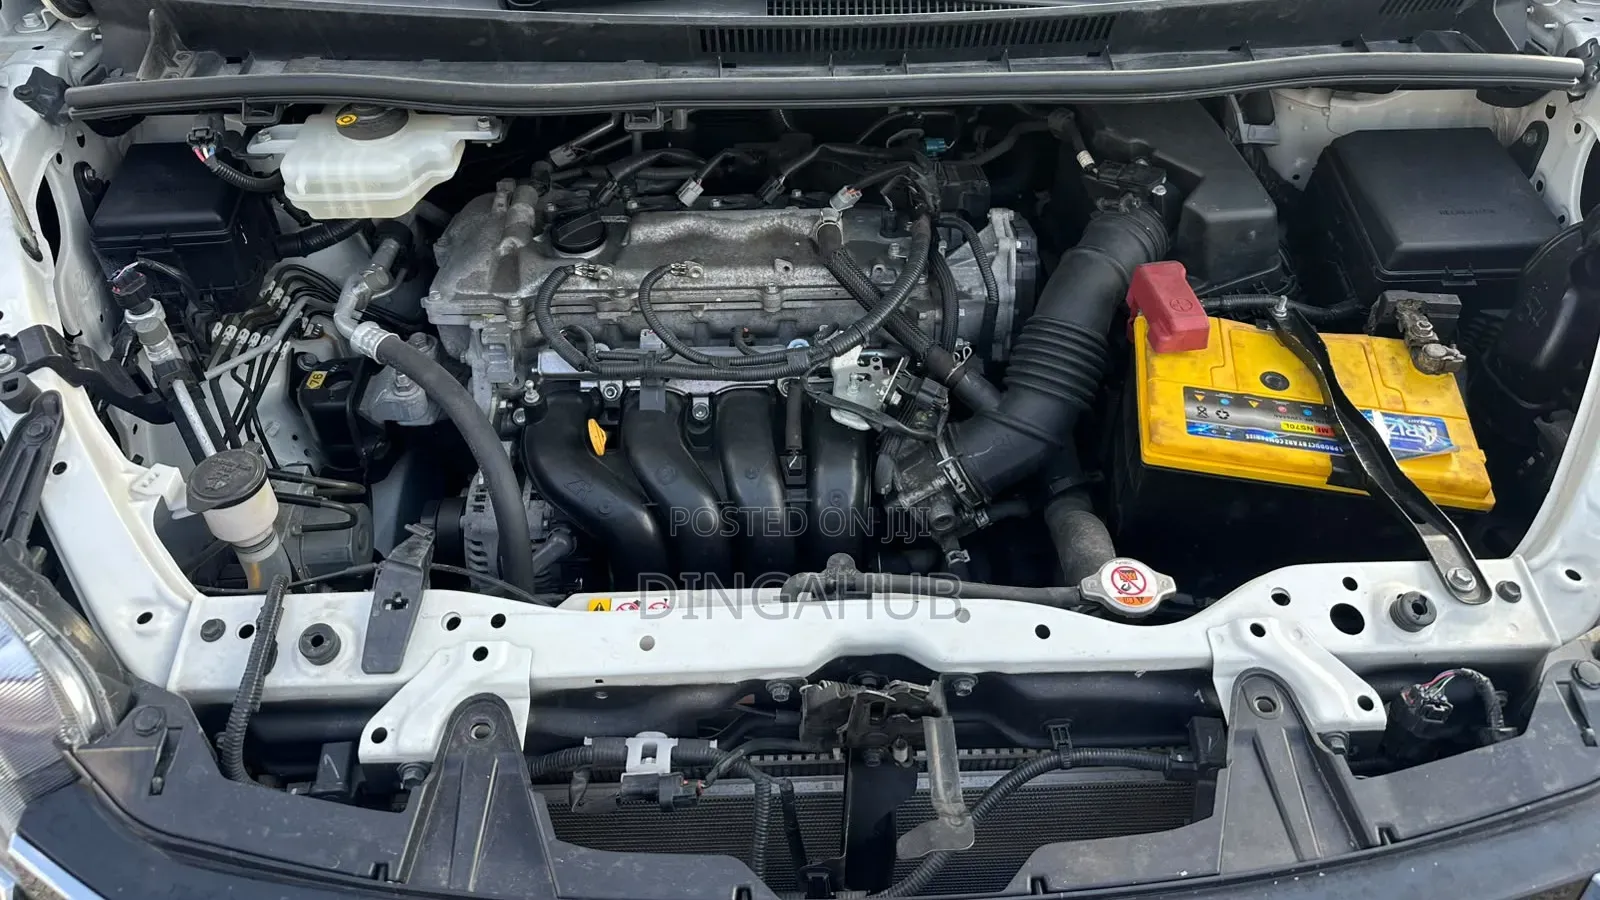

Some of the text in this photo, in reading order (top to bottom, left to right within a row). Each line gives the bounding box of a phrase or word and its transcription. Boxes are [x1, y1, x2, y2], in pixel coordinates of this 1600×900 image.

[1284, 422, 1314, 432] NS70L
[1245, 433, 1284, 444] COMPANIES
[1308, 442, 1339, 452] PRODUCT
